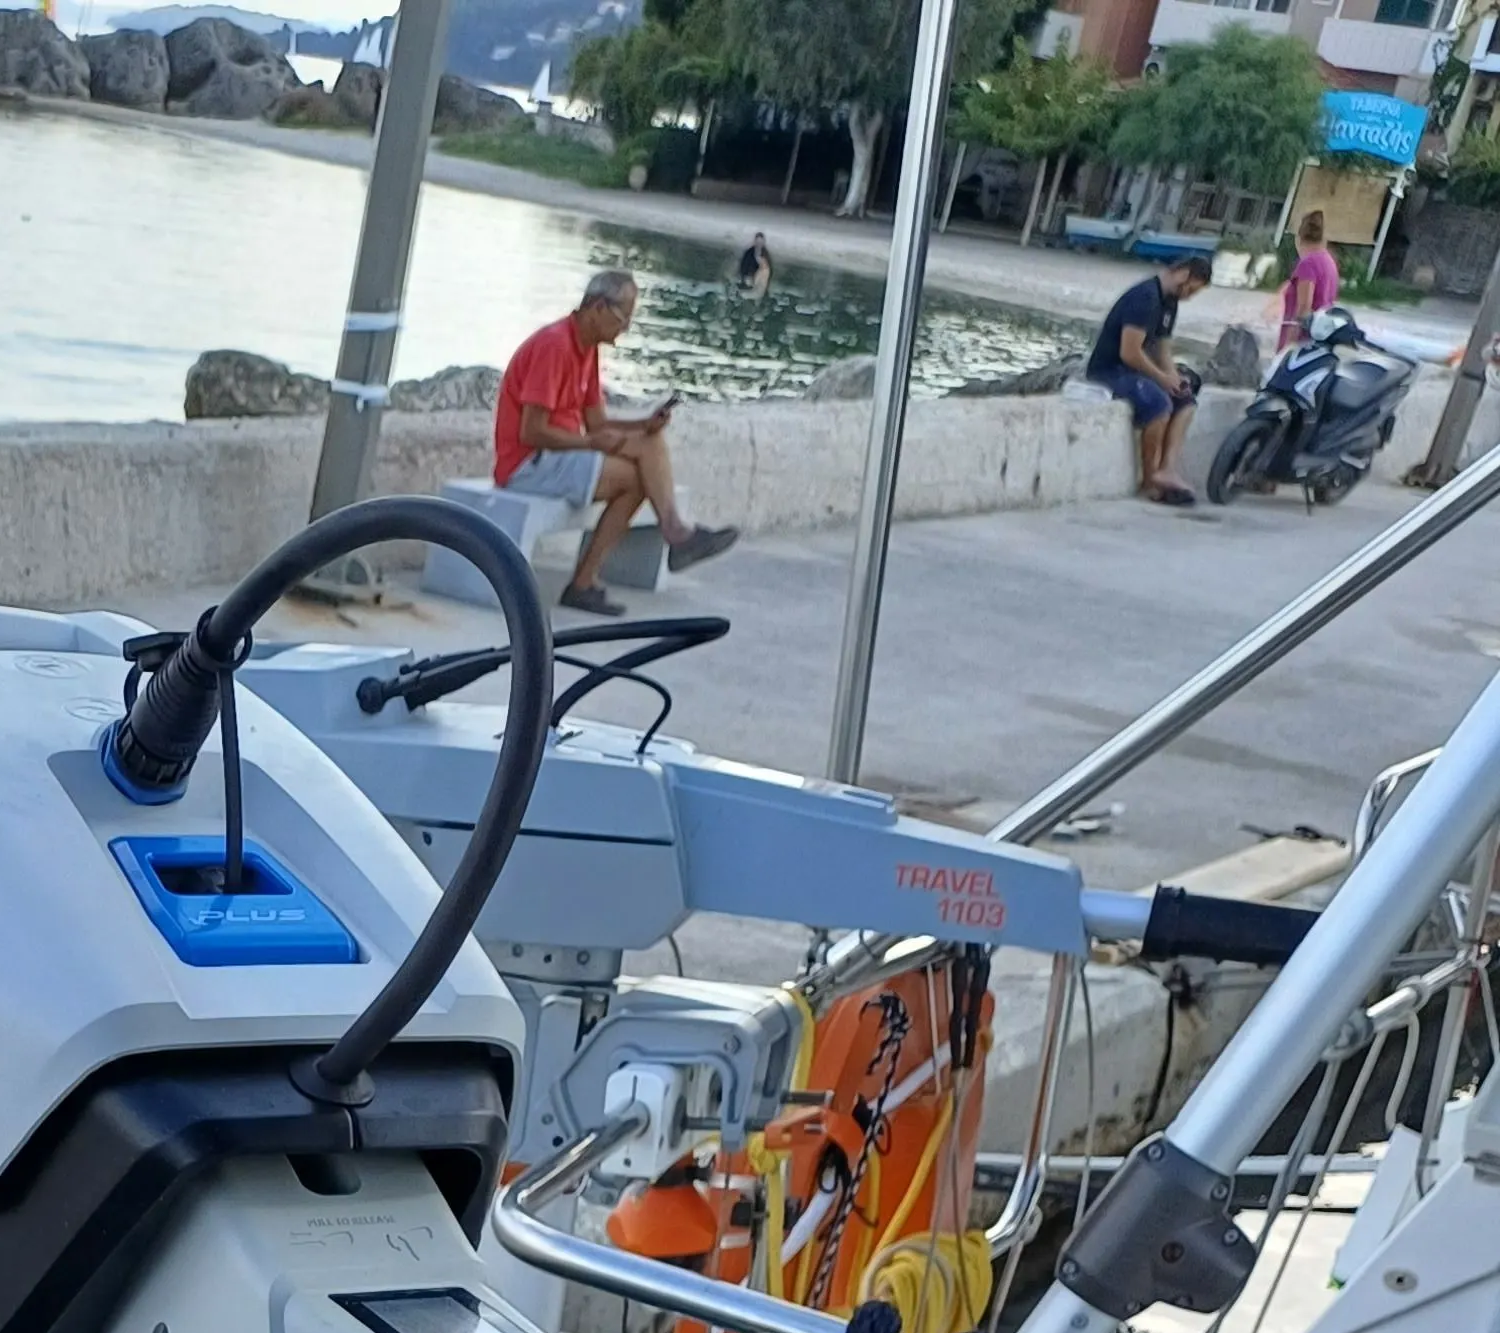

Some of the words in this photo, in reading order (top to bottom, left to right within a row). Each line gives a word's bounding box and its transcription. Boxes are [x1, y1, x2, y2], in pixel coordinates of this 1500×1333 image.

[896, 864, 999, 898] TRAVEL
[198, 909, 306, 926] PLUS
[937, 898, 1006, 928] 1103
